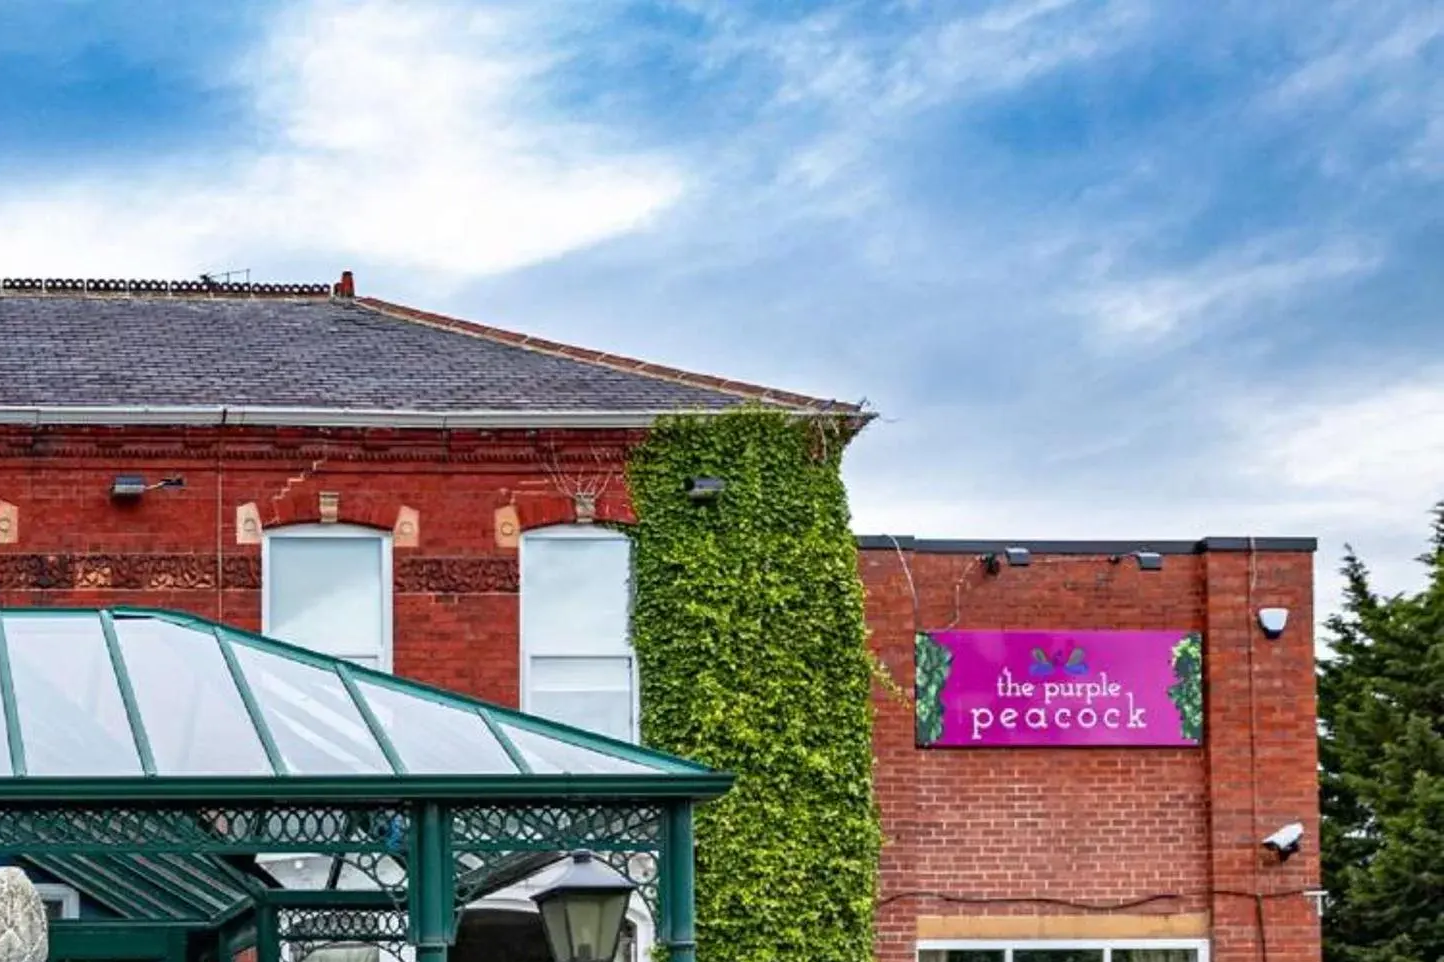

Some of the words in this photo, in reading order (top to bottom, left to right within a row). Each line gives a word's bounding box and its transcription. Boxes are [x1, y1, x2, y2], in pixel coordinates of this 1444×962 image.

[997, 666, 1034, 697] the
[1044, 672, 1121, 704] purple
[971, 692, 1147, 740] peacock
